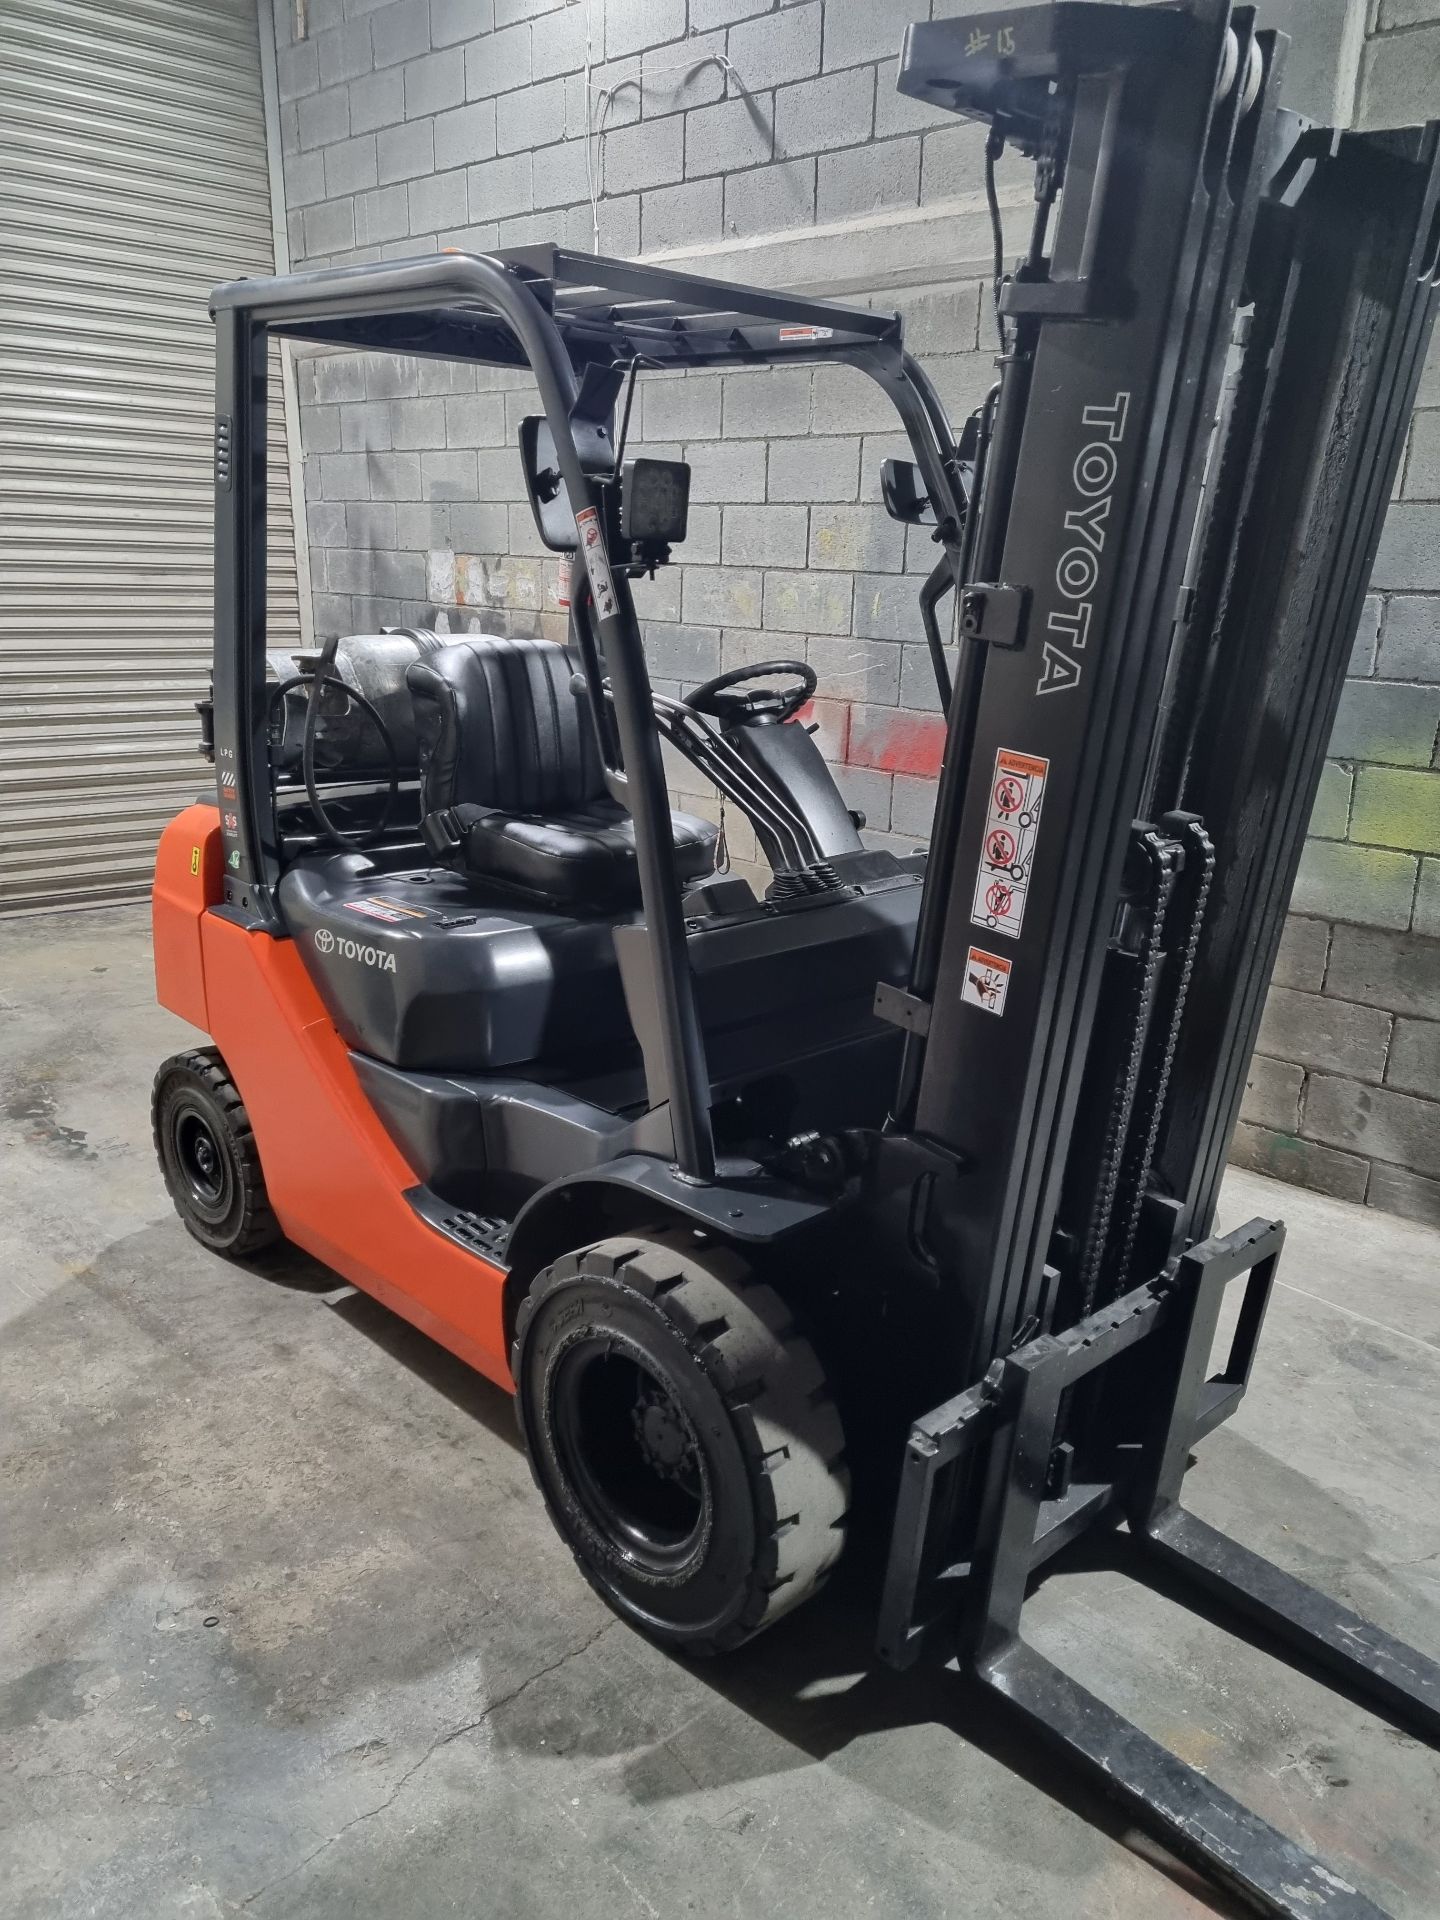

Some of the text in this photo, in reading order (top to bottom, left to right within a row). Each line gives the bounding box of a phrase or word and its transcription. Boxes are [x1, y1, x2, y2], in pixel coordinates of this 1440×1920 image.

[965, 26, 1015, 56] # 15
[1036, 392, 1130, 695] TOYOTA
[220, 748, 233, 758] LPG
[336, 937, 397, 973] TOYOTA
